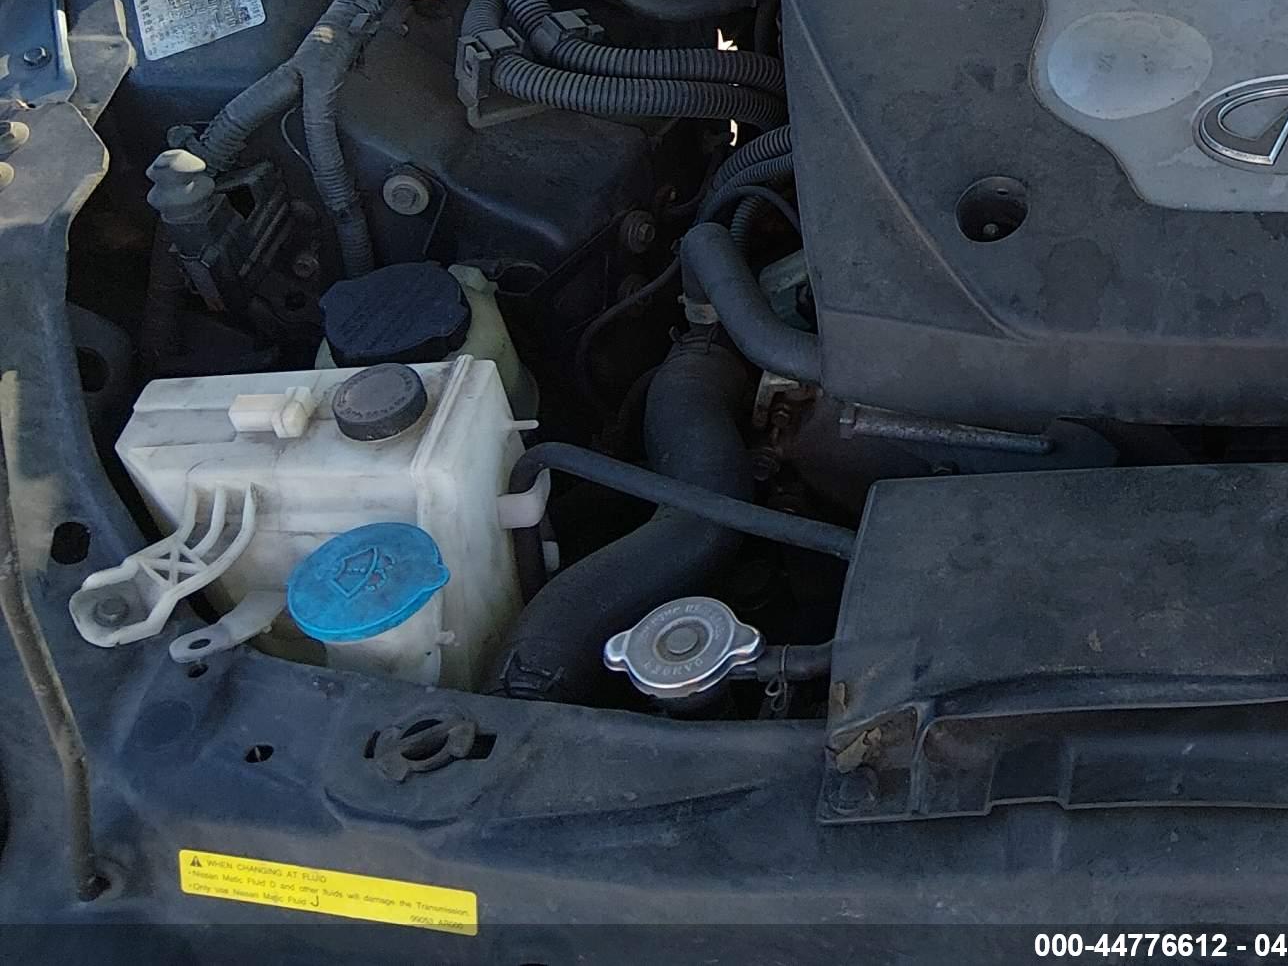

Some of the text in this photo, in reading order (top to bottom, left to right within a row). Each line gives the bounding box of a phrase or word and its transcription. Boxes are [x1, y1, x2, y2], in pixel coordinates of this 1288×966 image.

[207, 859, 327, 884] WHEN CHANGING AT FLUID
[222, 875, 243, 884] Matic
[248, 878, 266, 887] Fluid
[280, 883, 295, 891] and
[299, 885, 319, 894] other
[322, 889, 343, 899] fluids
[363, 895, 395, 906] damage
[399, 900, 412, 908] the
[233, 889, 259, 898] Nissan
[263, 892, 283, 903] Matic
[288, 896, 306, 906] Fluid
[310, 895, 319, 907] J
